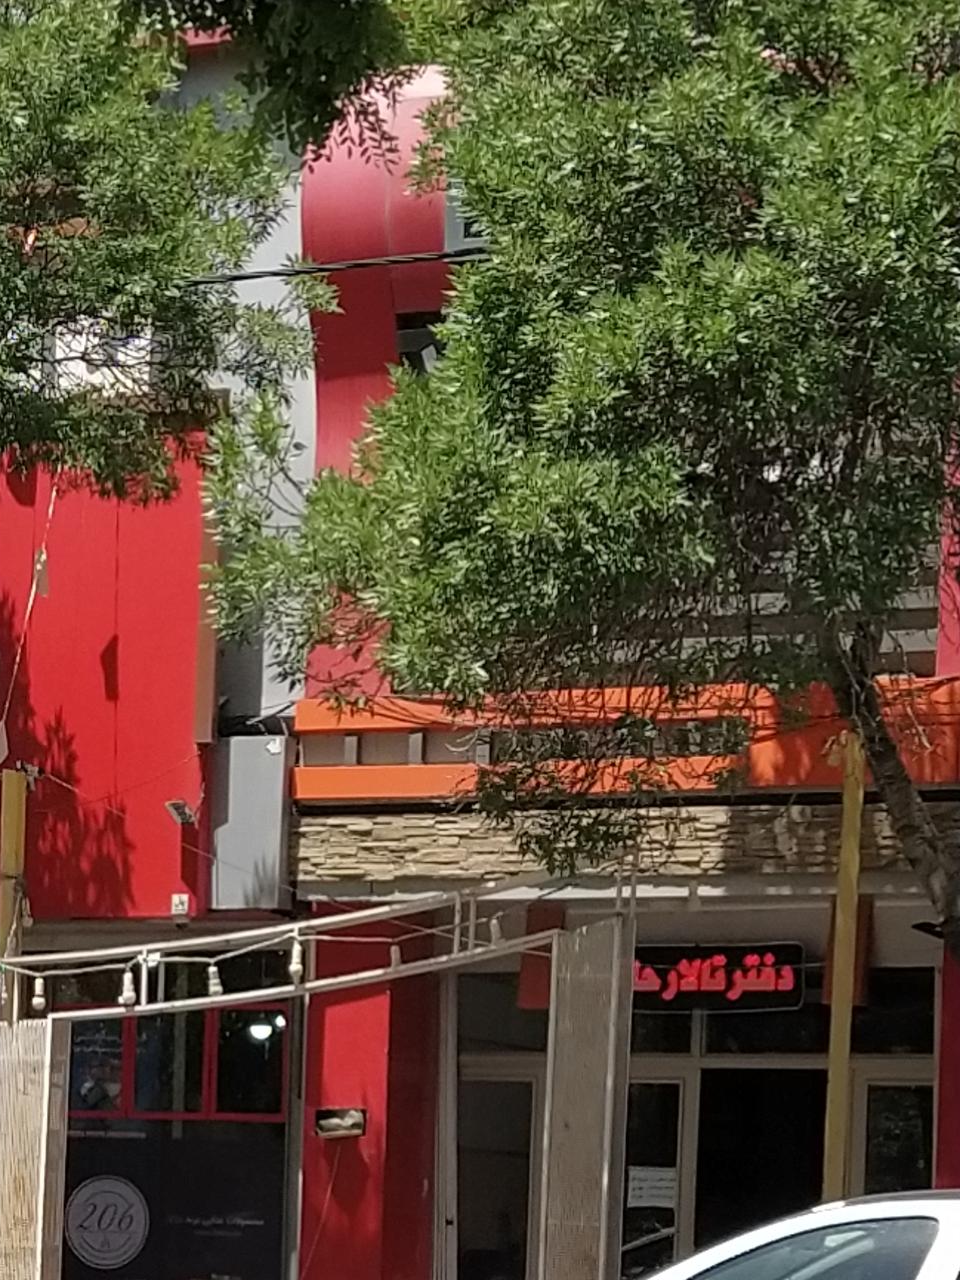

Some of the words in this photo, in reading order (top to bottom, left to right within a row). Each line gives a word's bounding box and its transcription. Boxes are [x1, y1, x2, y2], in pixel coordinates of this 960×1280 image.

[661, 953, 727, 1001] تالار
[726, 952, 795, 1001] دفتر
[76, 1202, 136, 1232] 206
